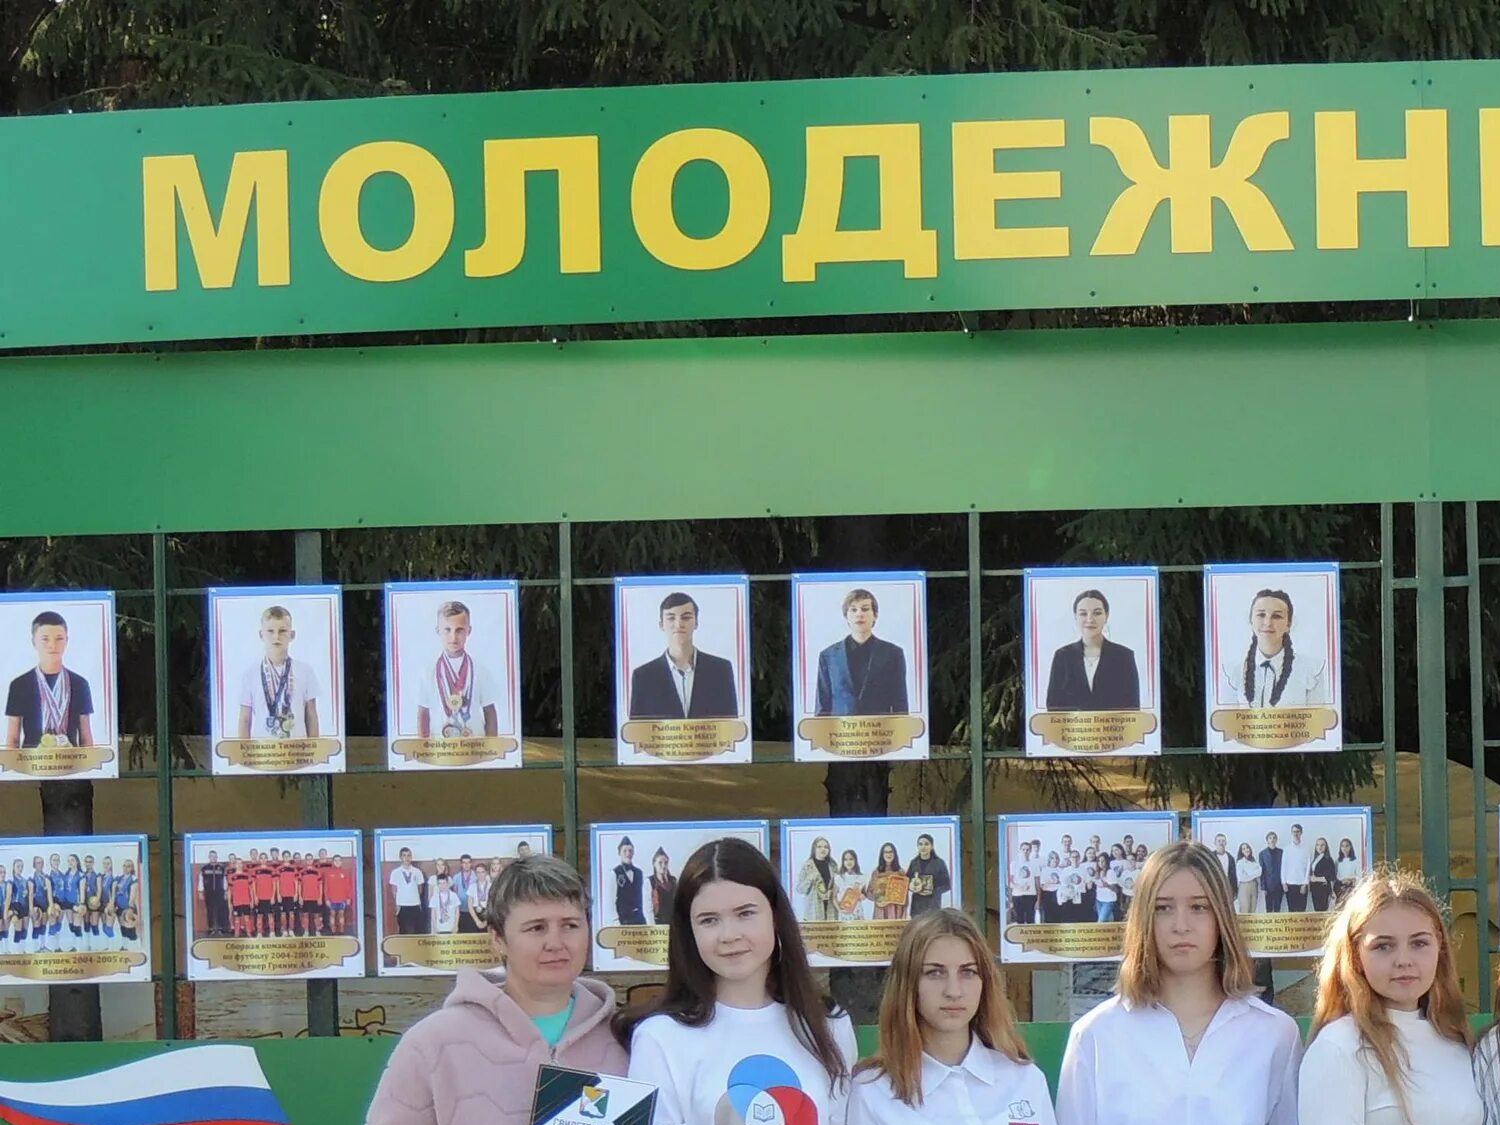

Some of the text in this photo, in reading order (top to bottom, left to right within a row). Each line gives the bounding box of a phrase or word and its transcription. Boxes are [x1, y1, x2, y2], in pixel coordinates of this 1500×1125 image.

[1093, 716, 1136, 724] Виктория
[1260, 712, 1312, 720] Александра
[683, 724, 717, 732] Кирилл
[842, 721, 857, 729] Тур
[278, 742, 317, 750] Тимофей
[55, 752, 87, 761] Никита
[235, 953, 269, 961] футболу
[271, 952, 313, 960] 2004-2005
[42, 968, 85, 976] Волейбол
